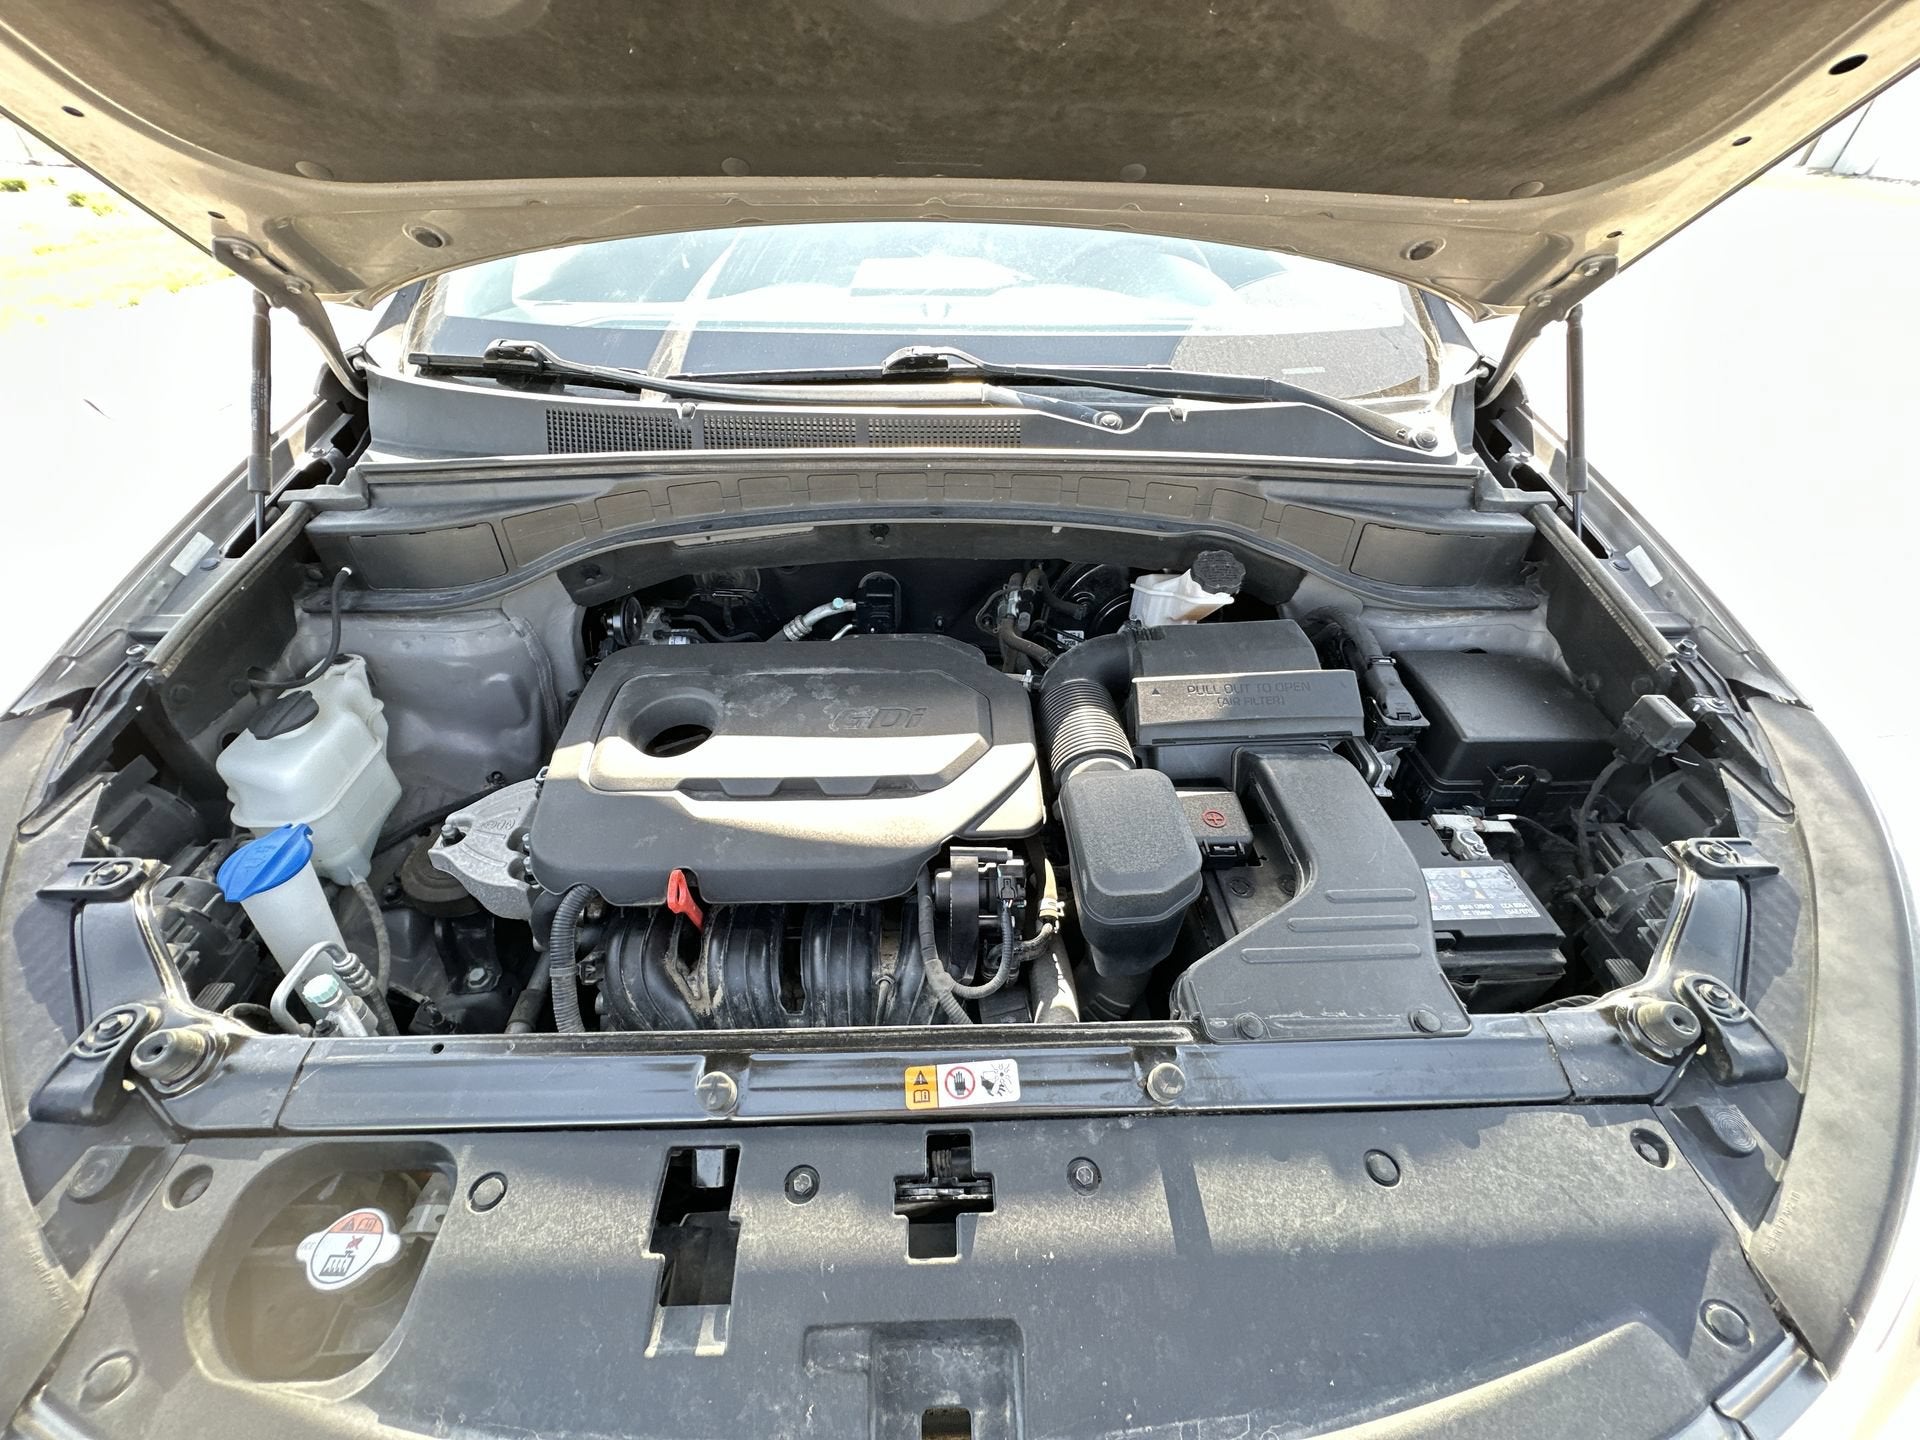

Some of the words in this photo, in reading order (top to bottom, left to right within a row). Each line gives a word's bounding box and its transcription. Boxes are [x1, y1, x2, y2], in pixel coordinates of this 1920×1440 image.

[1187, 684, 1221, 696] PULL
[1224, 683, 1250, 694] OUT
[1257, 682, 1272, 693] TO
[1275, 681, 1311, 692] OPEN
